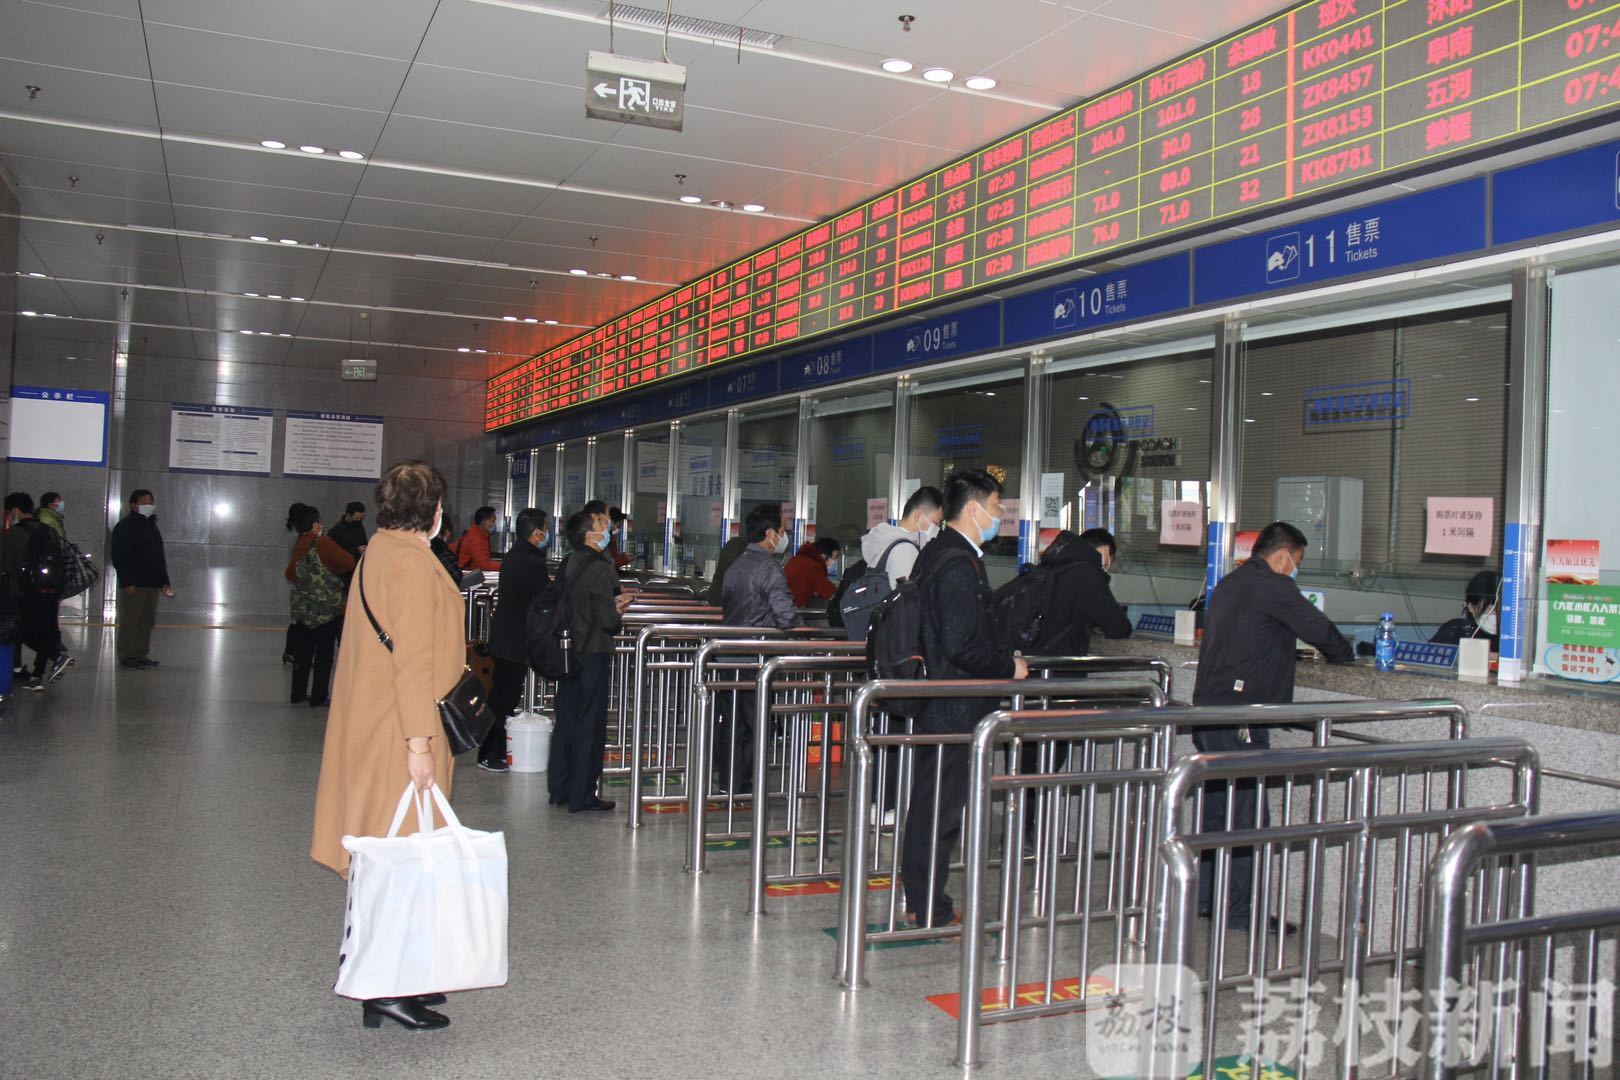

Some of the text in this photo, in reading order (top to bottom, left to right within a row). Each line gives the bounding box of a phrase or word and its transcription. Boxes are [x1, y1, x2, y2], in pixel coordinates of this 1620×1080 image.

[1228, 27, 1277, 68] 余票数
[1302, 25, 1374, 71] KK0441
[1426, 26, 1474, 65] 阜南
[1241, 71, 1262, 95] 18
[1302, 64, 1374, 110] ZK8457
[1426, 67, 1474, 110] 五河
[1158, 97, 1196, 128] 101.0
[1240, 107, 1261, 132] 28
[1302, 104, 1373, 148] ZK8153
[1426, 111, 1473, 150] 姜堰
[1240, 144, 1261, 167] 21
[1301, 144, 1373, 183] KK8781
[988, 170, 1016, 195] 07:20
[1240, 179, 1260, 202] 32
[986, 198, 1015, 222] 07:25
[1093, 192, 1120, 214] 71.0
[1160, 200, 1191, 224] 71.0
[985, 226, 1014, 249] 07:30
[1305, 217, 1381, 268] 11 售票
[985, 253, 1014, 276] 07:30
[1345, 246, 1378, 263] Tickets
[1079, 280, 1128, 317] 10 售票
[1104, 303, 1126, 316] Tickets
[923, 327, 941, 352] 09
[817, 355, 830, 376] 08
[41, 391, 74, 401] 公示栏
[1436, 510, 1482, 521] 购票时请保持
